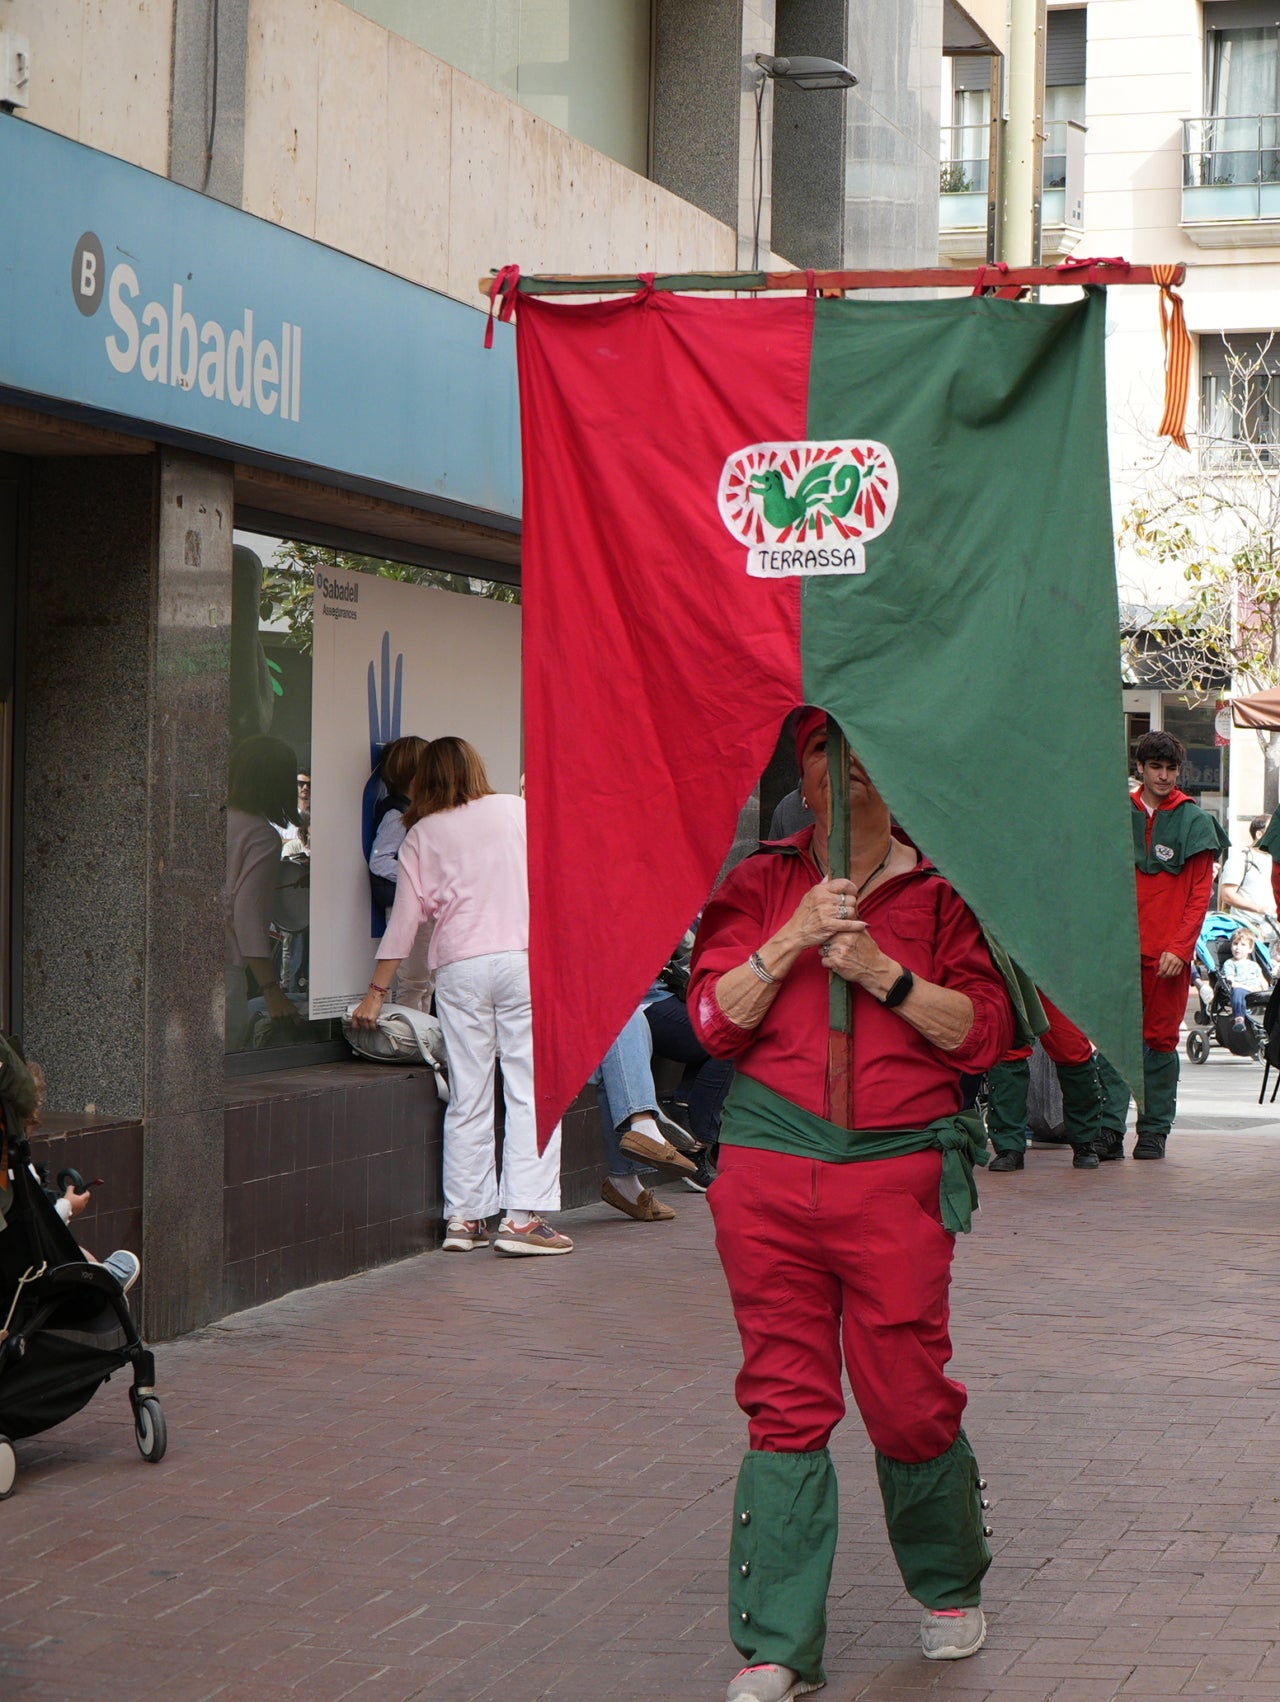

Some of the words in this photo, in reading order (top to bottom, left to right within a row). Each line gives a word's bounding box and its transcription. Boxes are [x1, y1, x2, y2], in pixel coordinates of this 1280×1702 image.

[80, 250, 97, 297] B
[104, 262, 302, 423] Sabadell
[758, 548, 856, 571] TERRASSA
[322, 577, 359, 604] Sabadell
[322, 603, 358, 621] Assegurances
